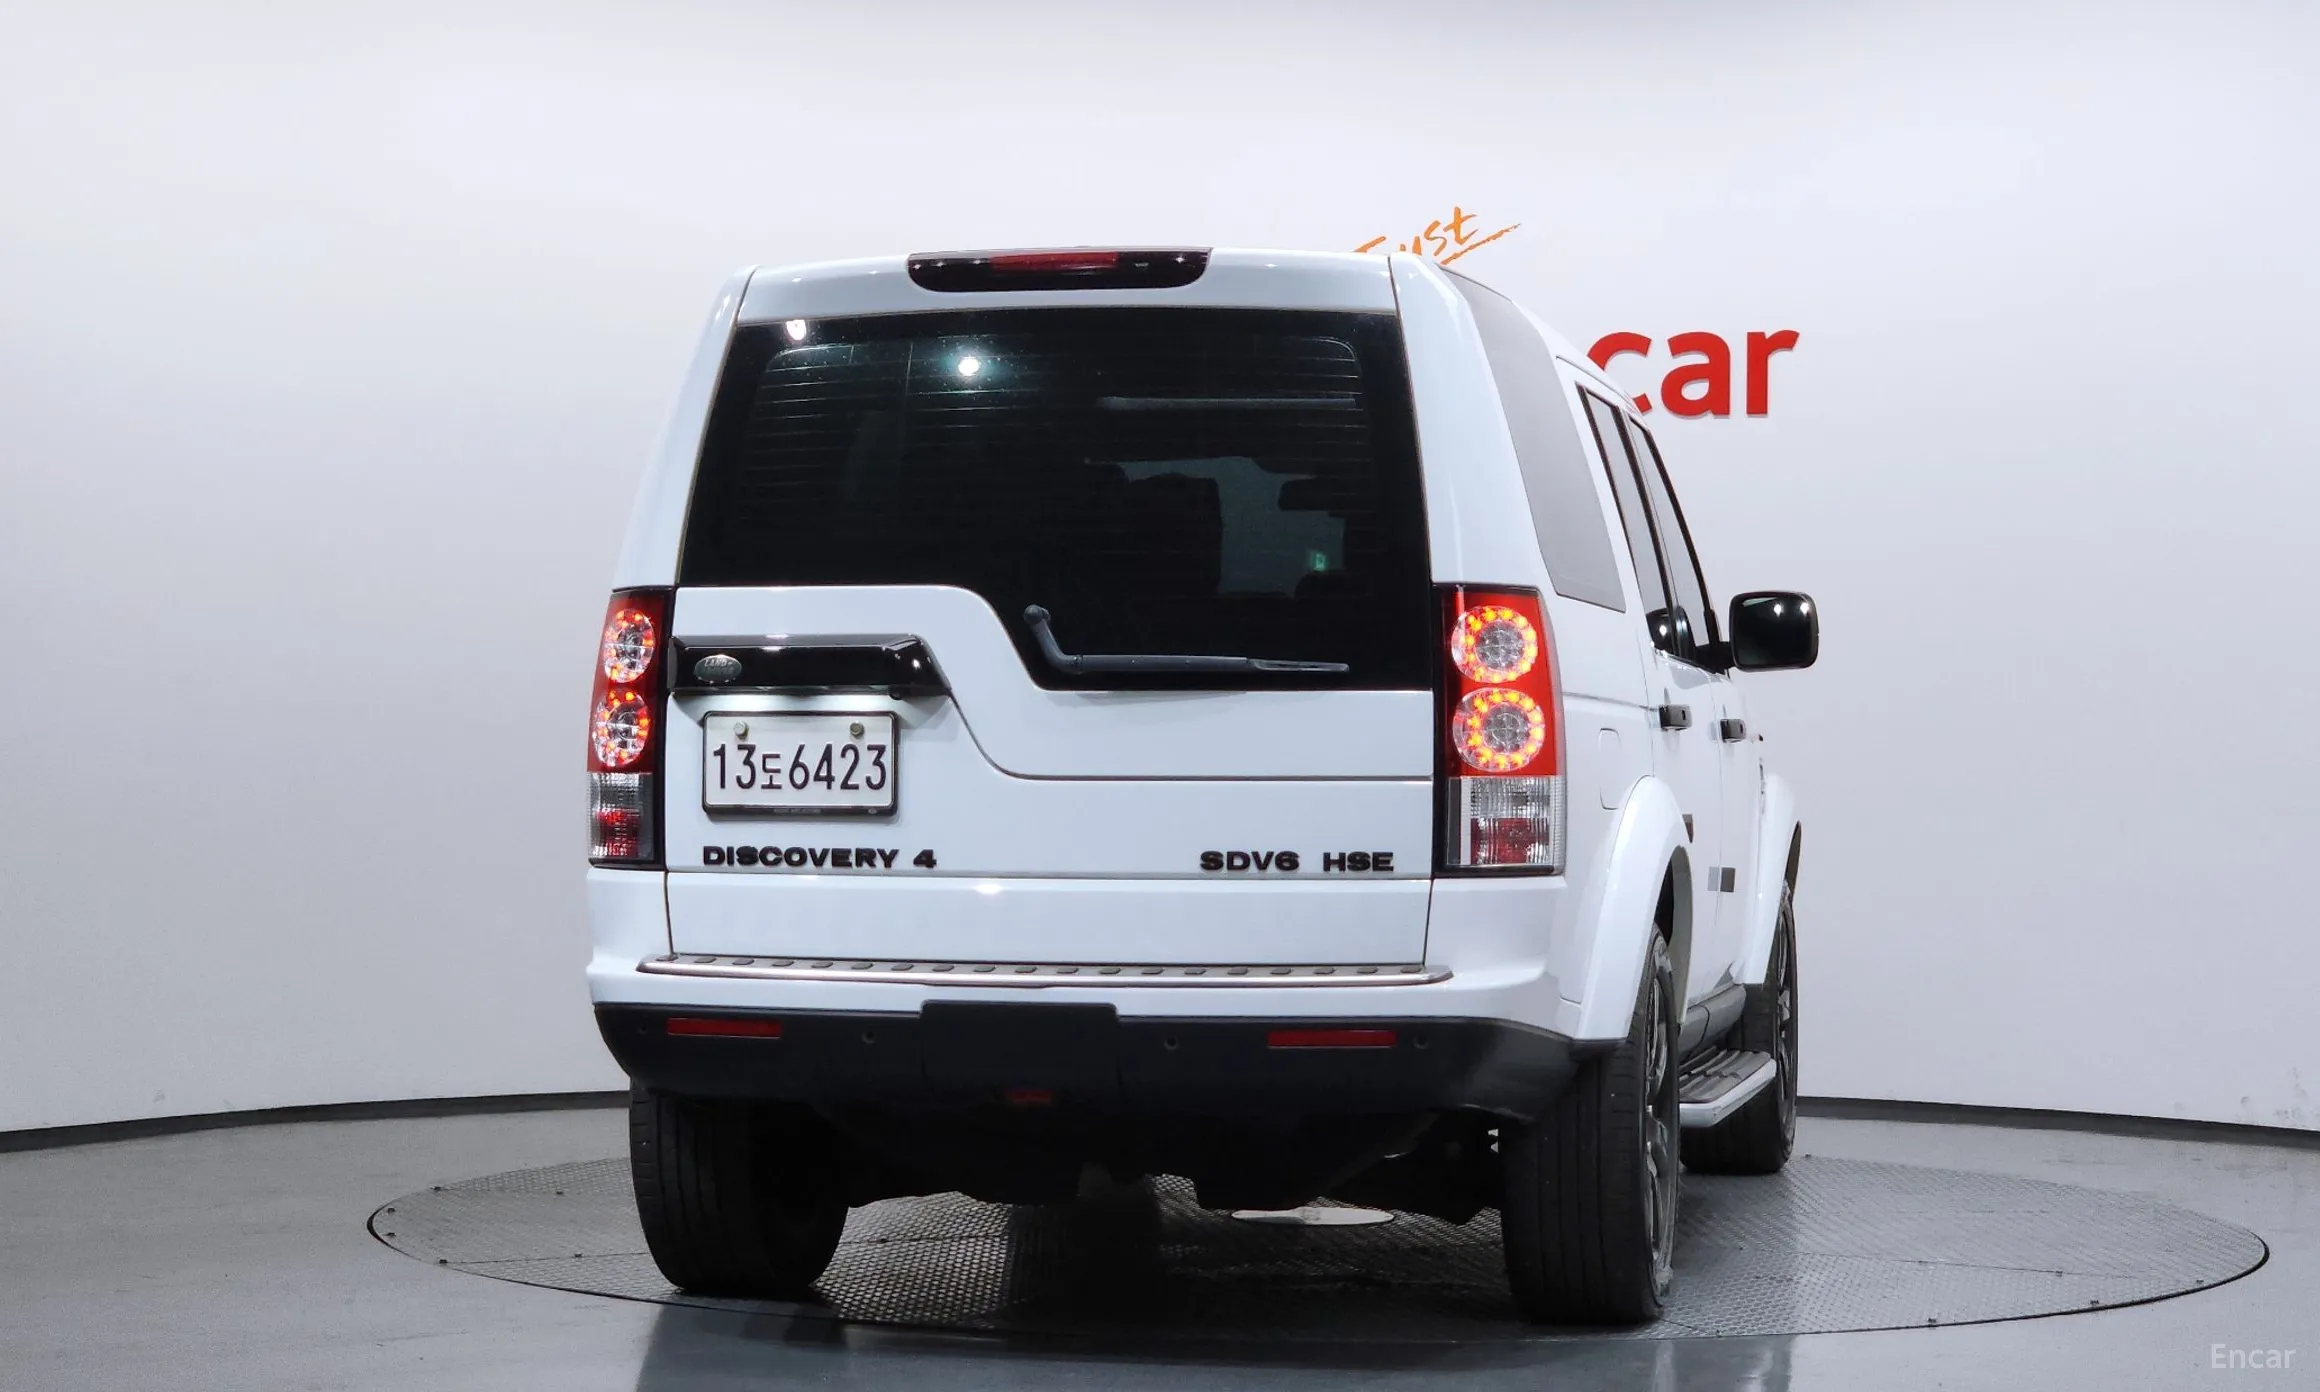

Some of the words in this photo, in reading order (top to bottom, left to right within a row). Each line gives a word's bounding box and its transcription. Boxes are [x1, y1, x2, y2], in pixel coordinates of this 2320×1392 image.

[713, 743, 887, 791] 13도6423
[703, 846, 899, 868] DISCOVERY
[913, 849, 937, 869] 4
[1200, 850, 1300, 872] SDV6
[1322, 852, 1394, 872] HSE
